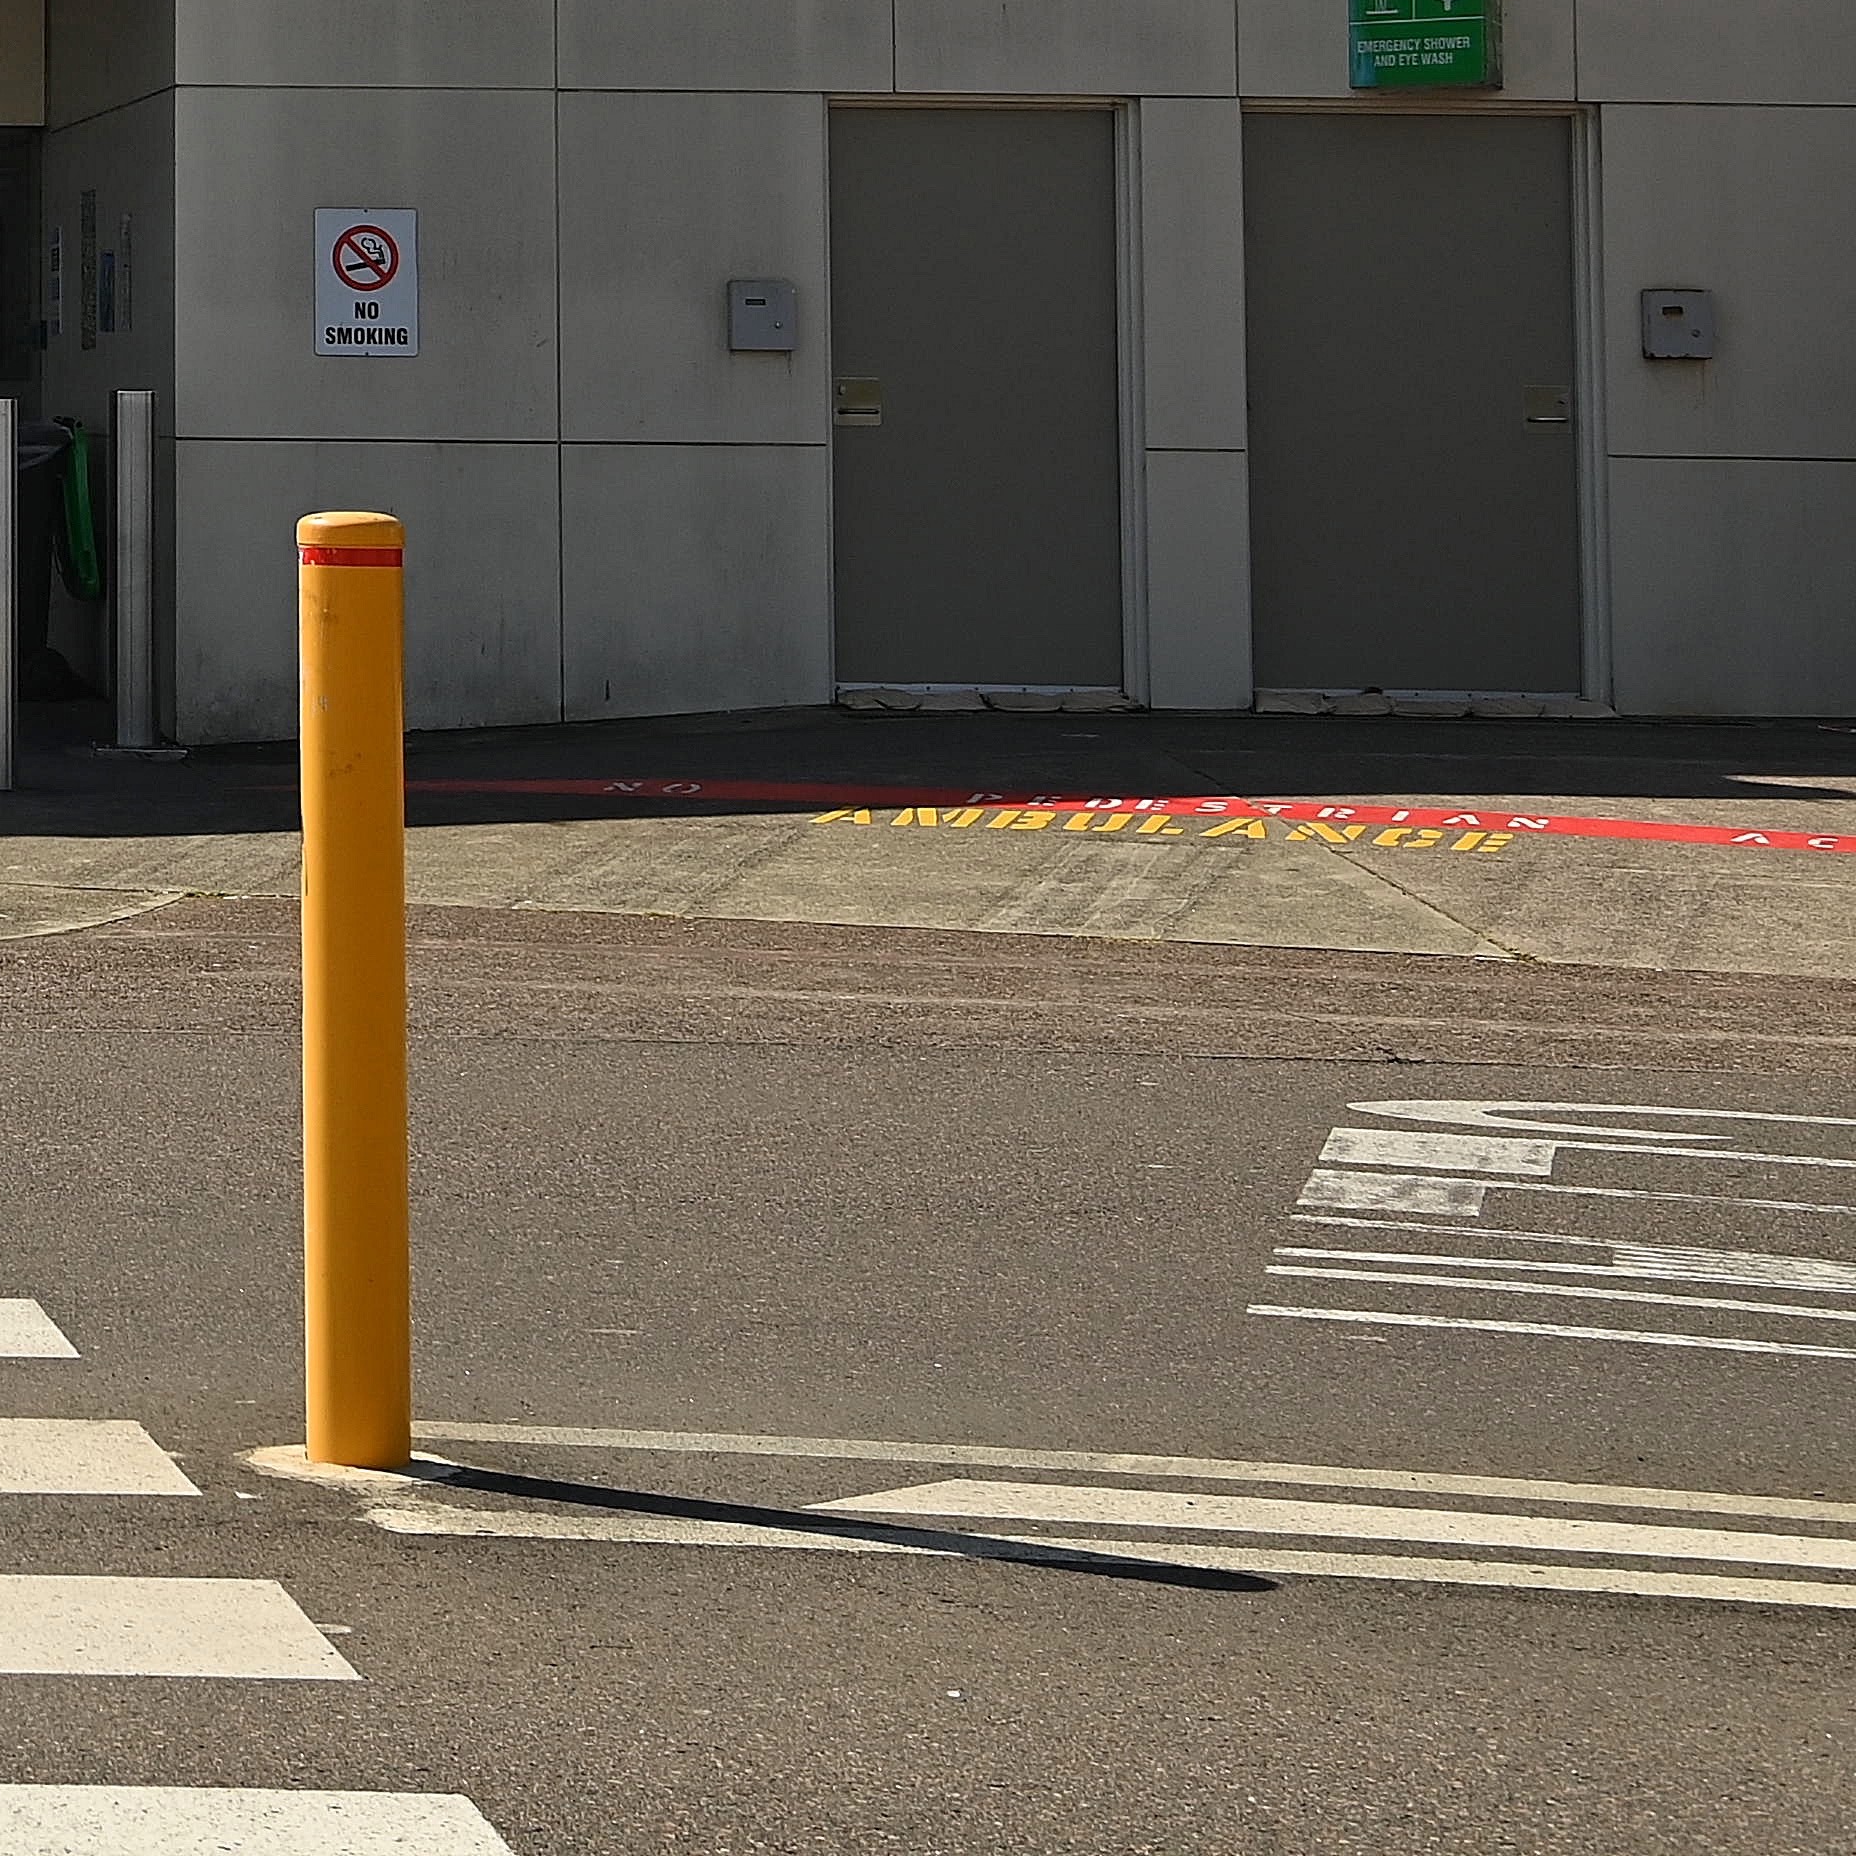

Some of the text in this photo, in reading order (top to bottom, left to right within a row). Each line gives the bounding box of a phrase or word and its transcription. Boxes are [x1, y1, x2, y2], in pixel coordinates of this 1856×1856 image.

[1358, 36, 1471, 53] EMERGENCY SHOWER
[1374, 52, 1453, 67] AND EYE WASH
[354, 302, 379, 320] NO
[325, 327, 408, 345] SMOKING
[603, 780, 703, 794] NO
[966, 791, 1551, 831] PEDESTRIAN
[809, 806, 1516, 852] AMBULANCE
